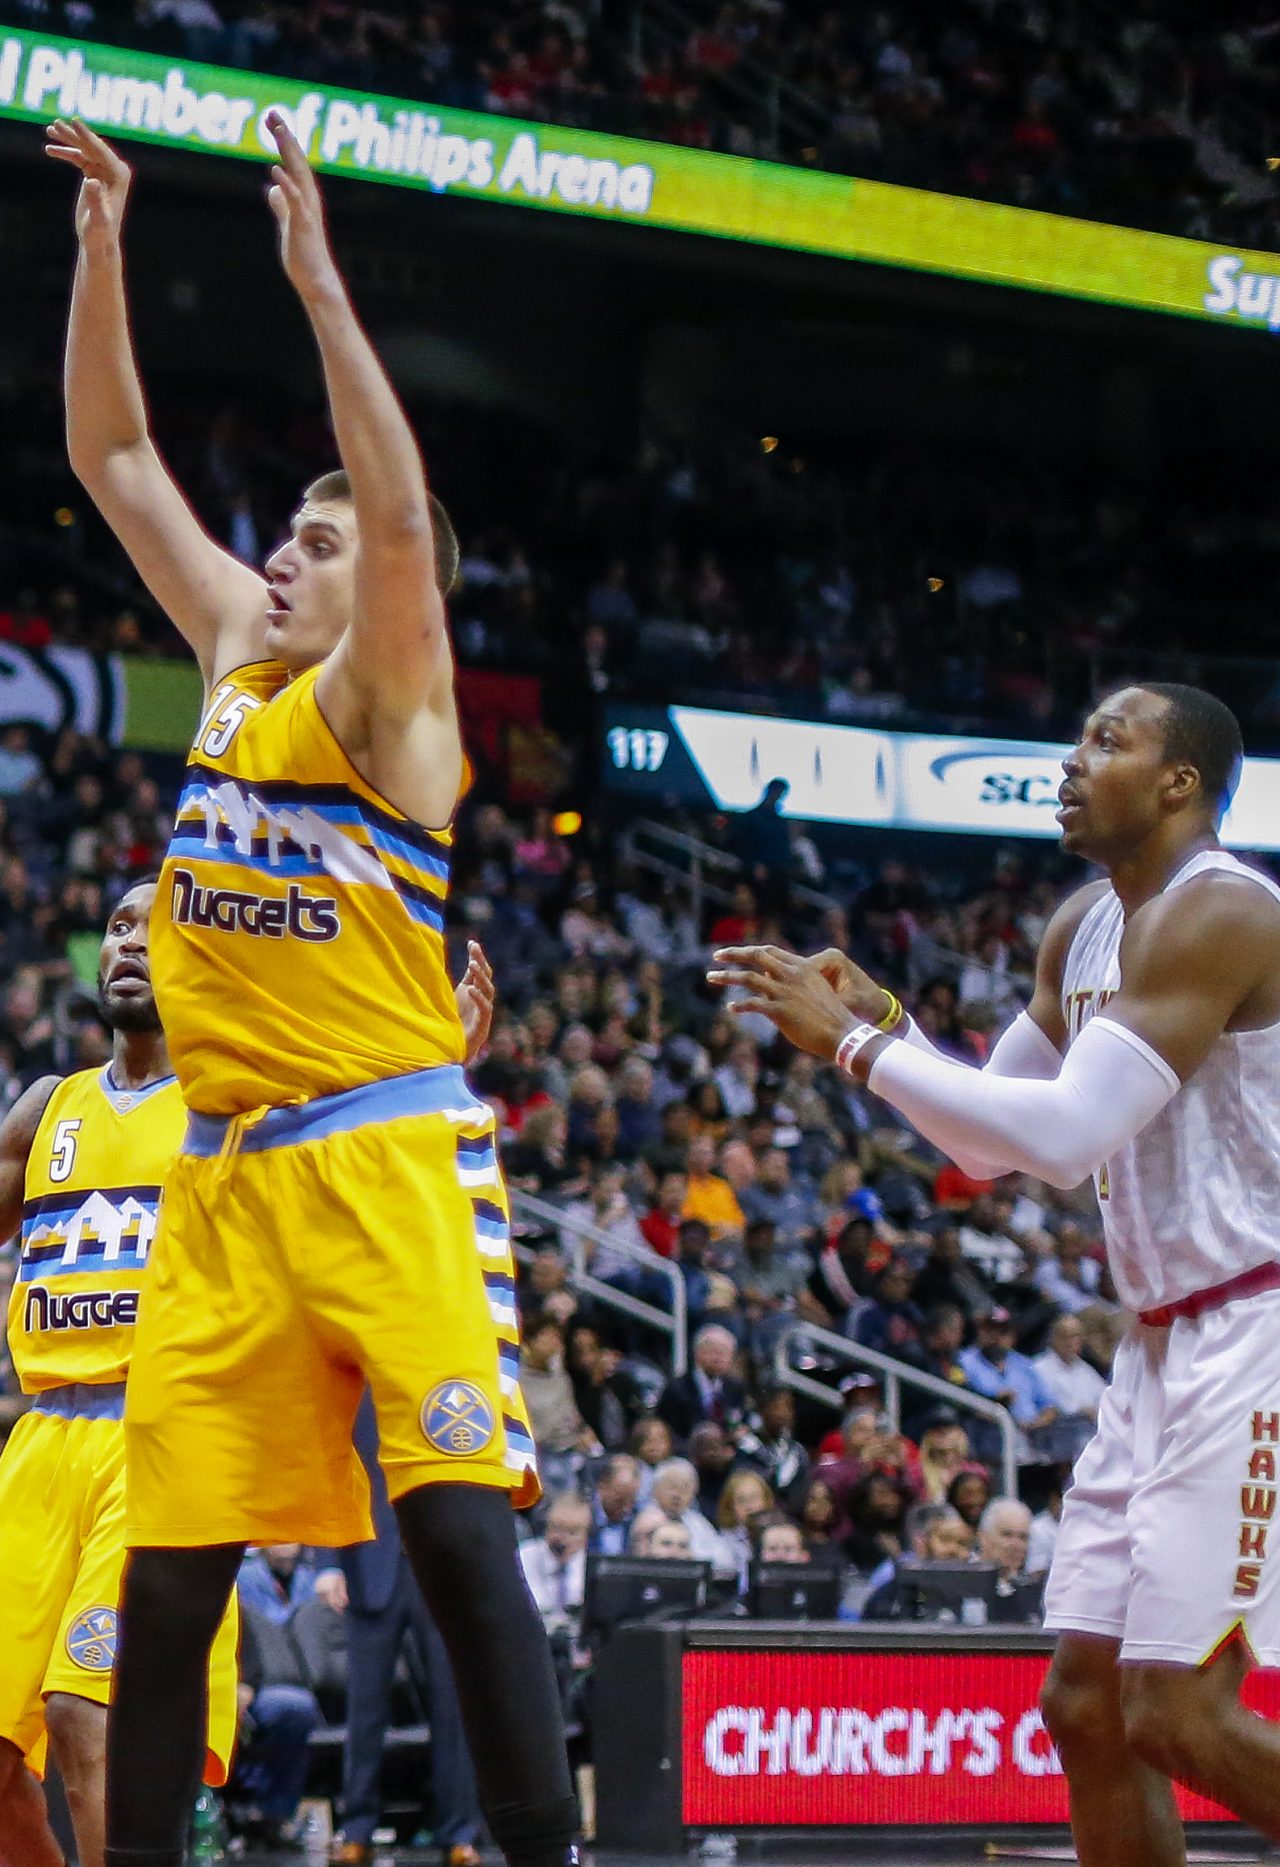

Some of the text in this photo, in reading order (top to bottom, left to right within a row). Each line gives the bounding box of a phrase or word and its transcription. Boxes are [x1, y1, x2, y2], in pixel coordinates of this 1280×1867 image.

[24, 46, 254, 146] Plumber
[256, 92, 324, 156] of
[322, 99, 494, 194] Philips
[499, 133, 654, 213] Arena
[192, 683, 262, 759] 15
[979, 772, 1062, 806] SC
[48, 1118, 82, 1184] 5
[24, 1285, 140, 1334] Nugge
[1233, 1409, 1280, 1597] HAWKS
[703, 1704, 1005, 1777] CHURCH'S
